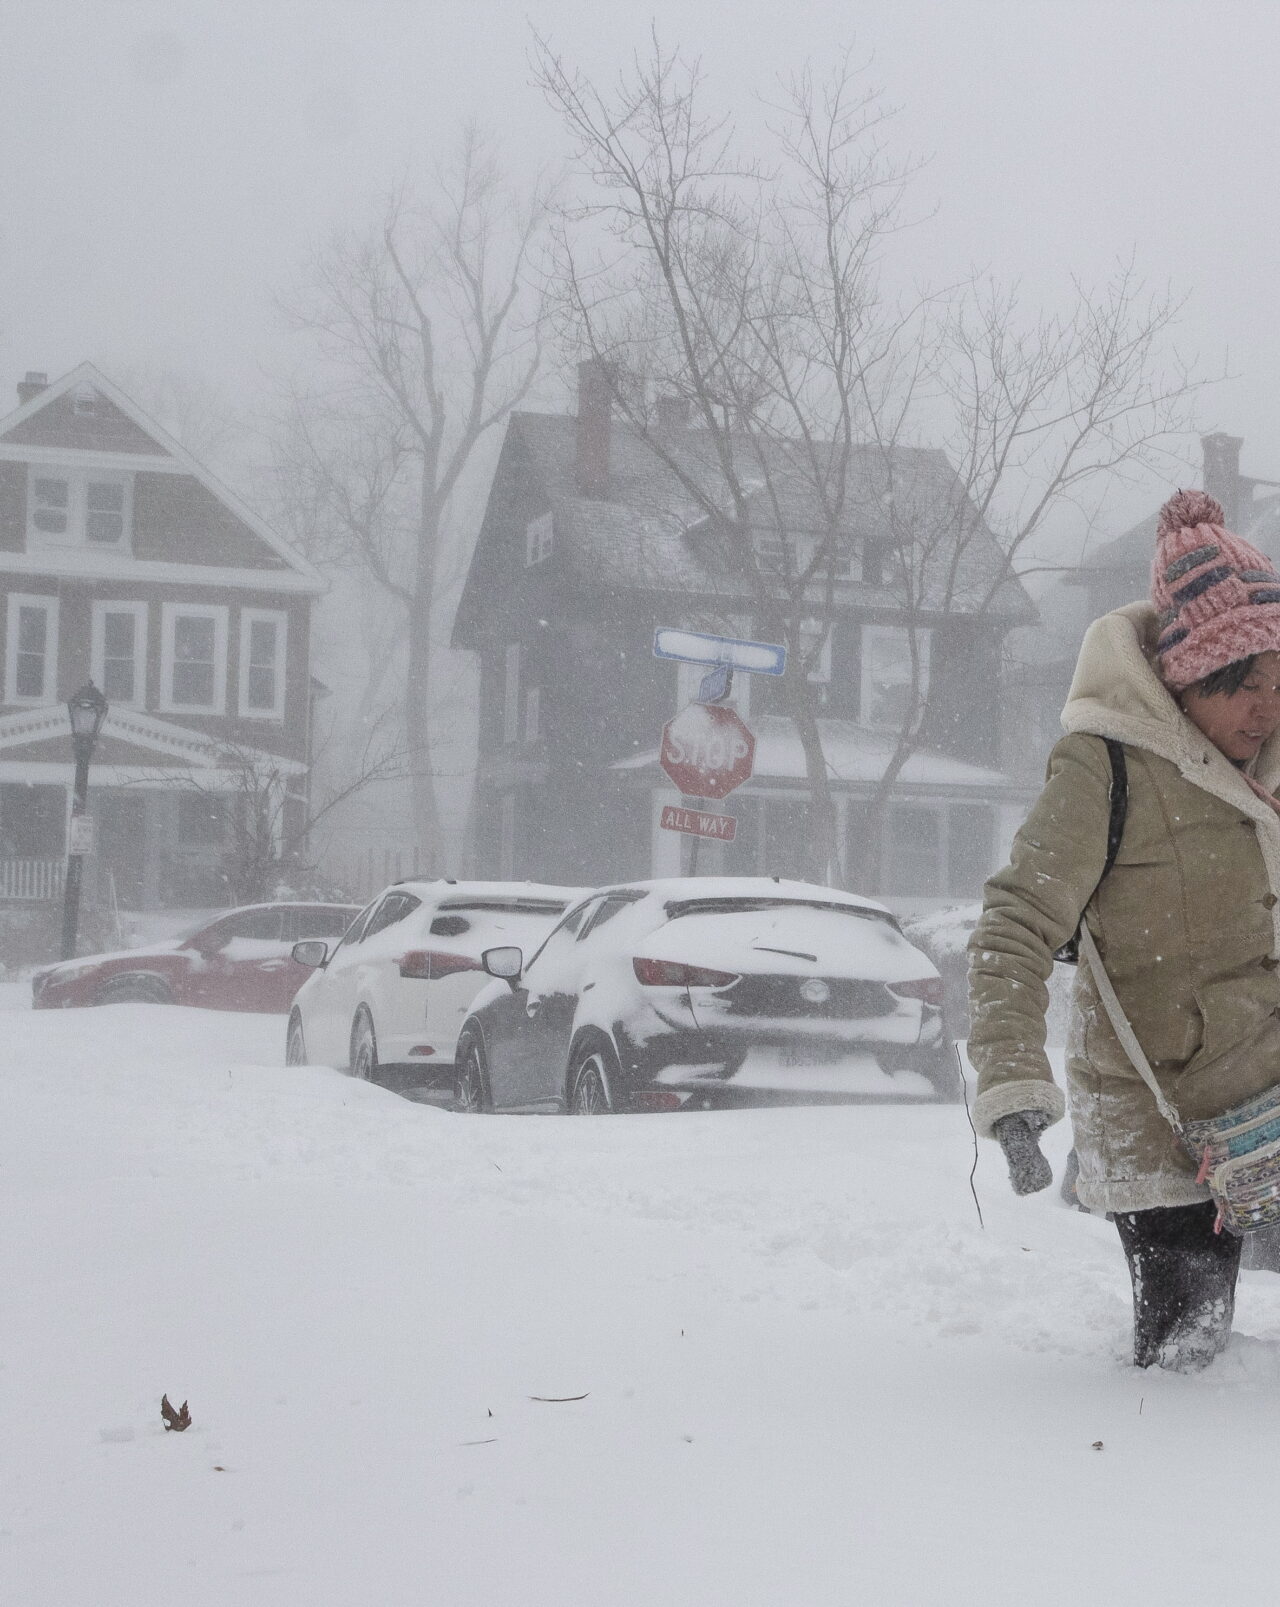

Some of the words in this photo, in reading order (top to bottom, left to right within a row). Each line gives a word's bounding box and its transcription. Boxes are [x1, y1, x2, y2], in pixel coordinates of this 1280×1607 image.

[666, 734, 750, 770] STOP
[666, 813, 691, 829] ALL
[698, 816, 728, 834] WAY
